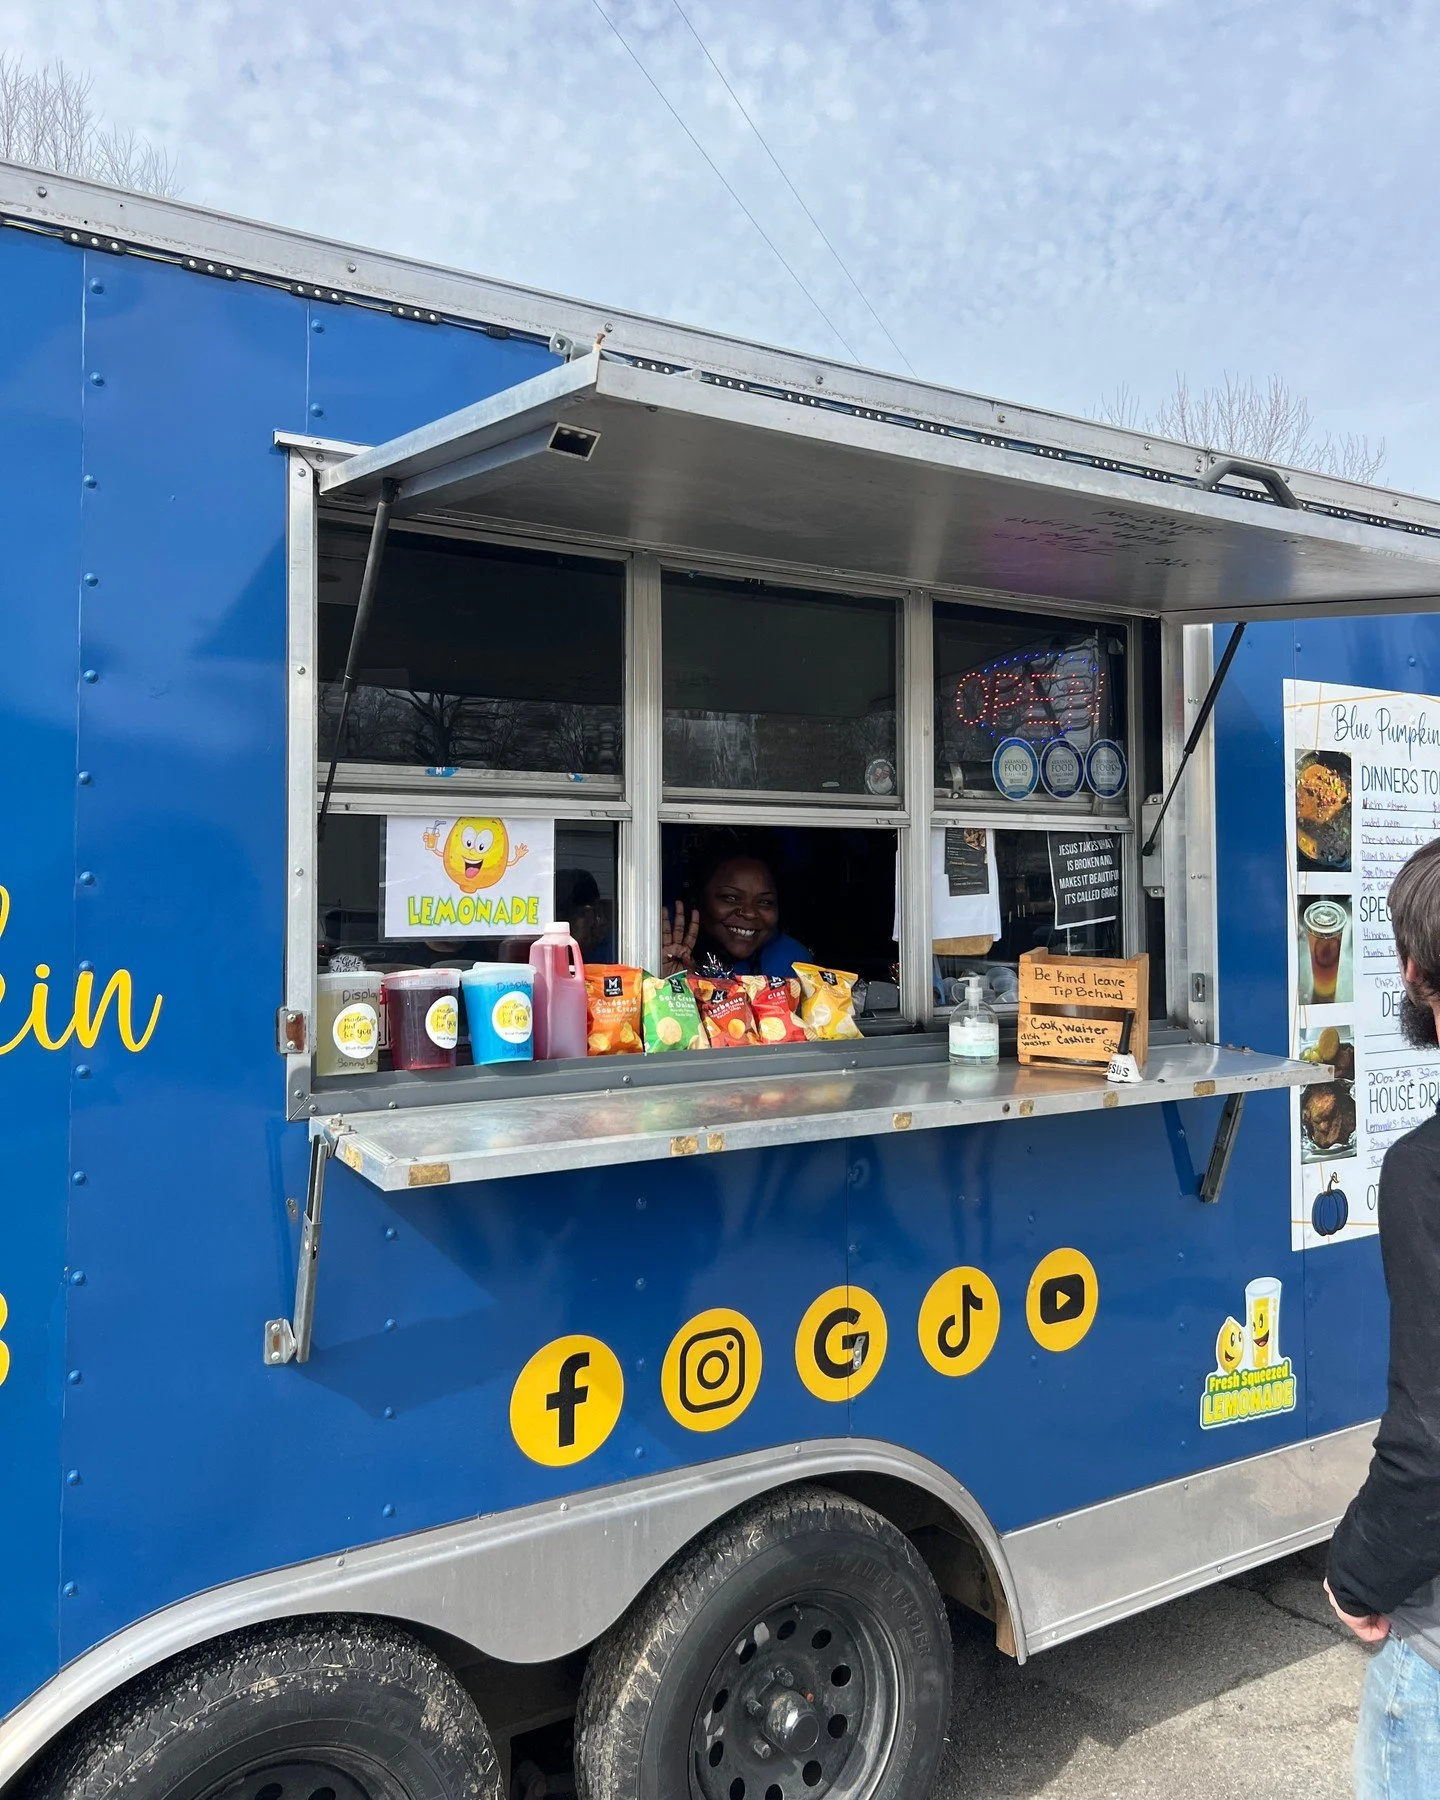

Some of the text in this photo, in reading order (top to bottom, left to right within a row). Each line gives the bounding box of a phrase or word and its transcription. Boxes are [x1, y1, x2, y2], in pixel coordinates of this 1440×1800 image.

[955, 672, 1106, 726] OPEN
[1331, 703, 1372, 742] Blue
[1004, 763, 1028, 772] FOOD
[1052, 763, 1074, 772] FOOD
[1361, 765, 1440, 795] DINNERS TO
[1059, 838, 1114, 856] JESUS TAKES WHAT
[1066, 854, 1113, 871] IS BROKEN AND
[1059, 875, 1081, 890] MAKES
[1081, 874, 1088, 886] IT
[1064, 892, 1076, 906] IT'S
[1076, 889, 1100, 903] CALLED
[407, 895, 540, 927] LEMONADE
[1034, 967, 1051, 981] Be
[1094, 973, 1125, 987] leave
[1049, 986, 1072, 998] Tip
[596, 1006, 615, 1014] Sour
[597, 998, 630, 1007] Cheddar
[668, 1000, 674, 1008] &
[1370, 1084, 1415, 1114] HOUSE
[1209, 1362, 1289, 1392] Fresh Squeezed
[1202, 1378, 1294, 1425] LEMONADE
